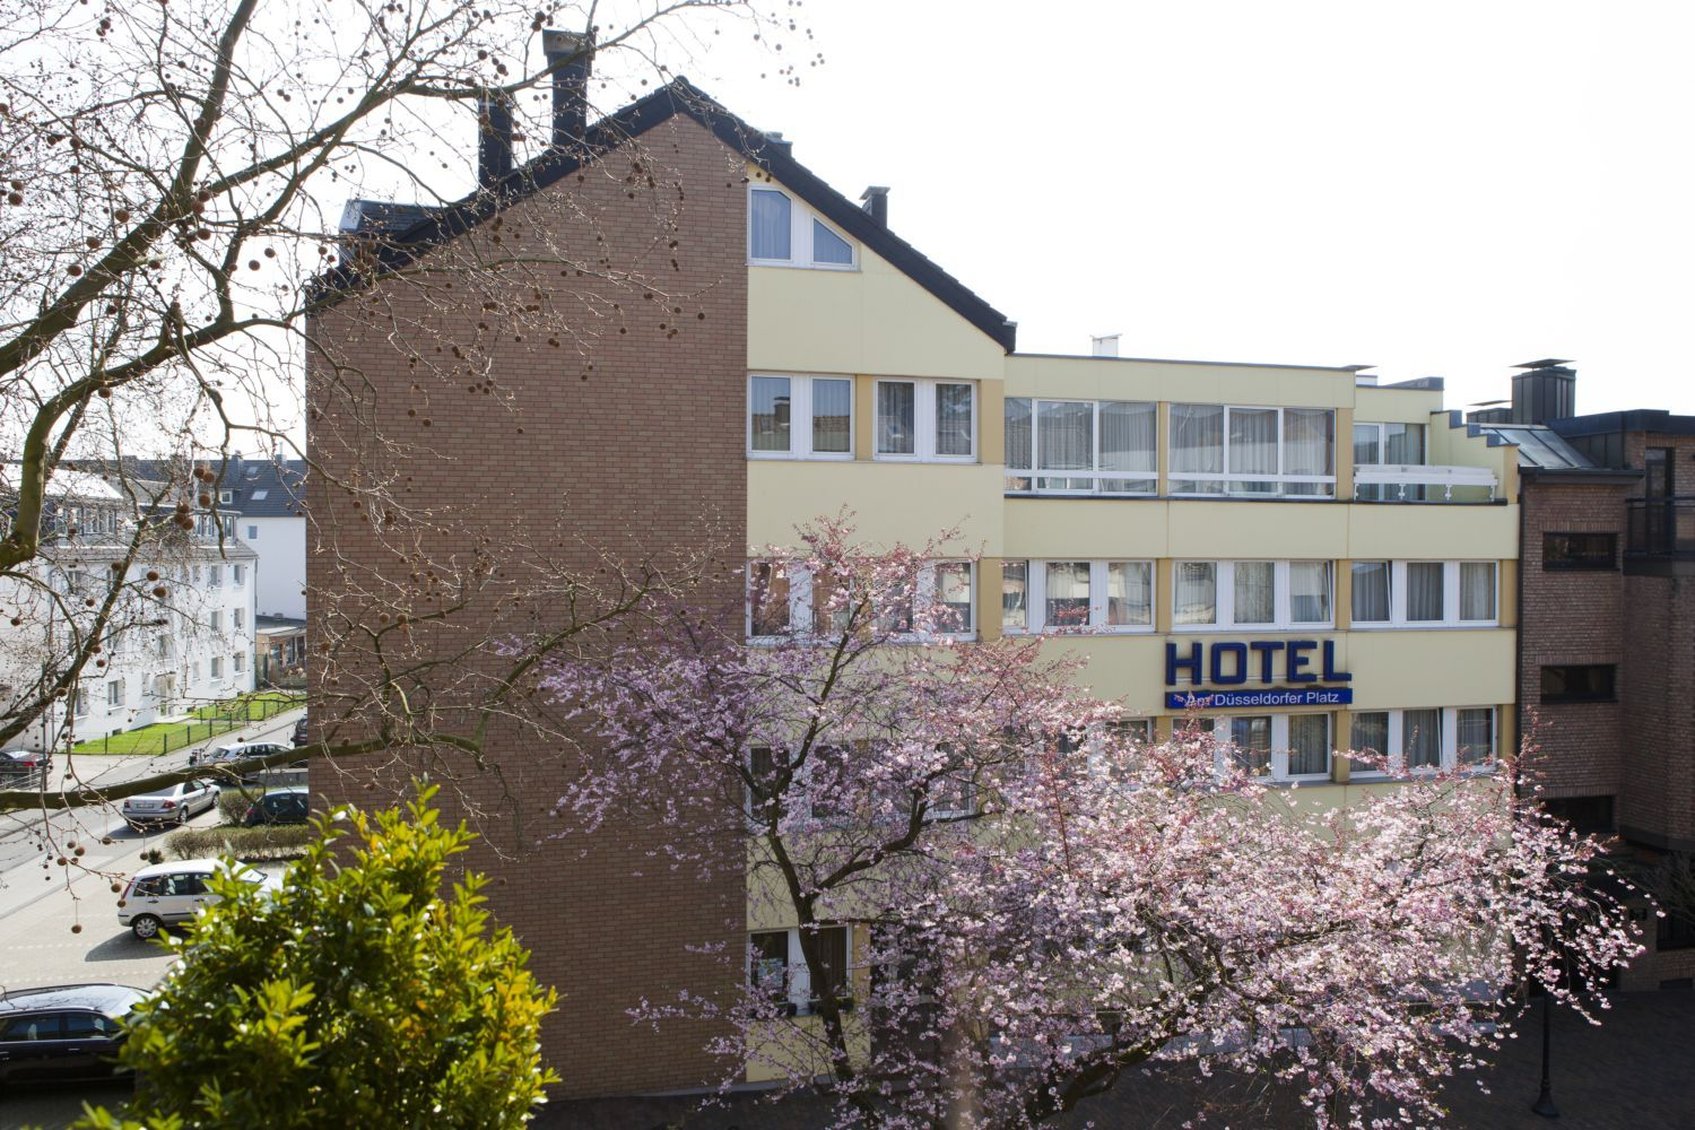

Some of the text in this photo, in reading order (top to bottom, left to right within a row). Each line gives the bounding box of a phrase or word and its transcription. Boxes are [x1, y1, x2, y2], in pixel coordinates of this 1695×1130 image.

[1165, 640, 1352, 685] HOTEL
[1215, 692, 1302, 706] Düsseldorfer
[1306, 691, 1339, 703] Platz
